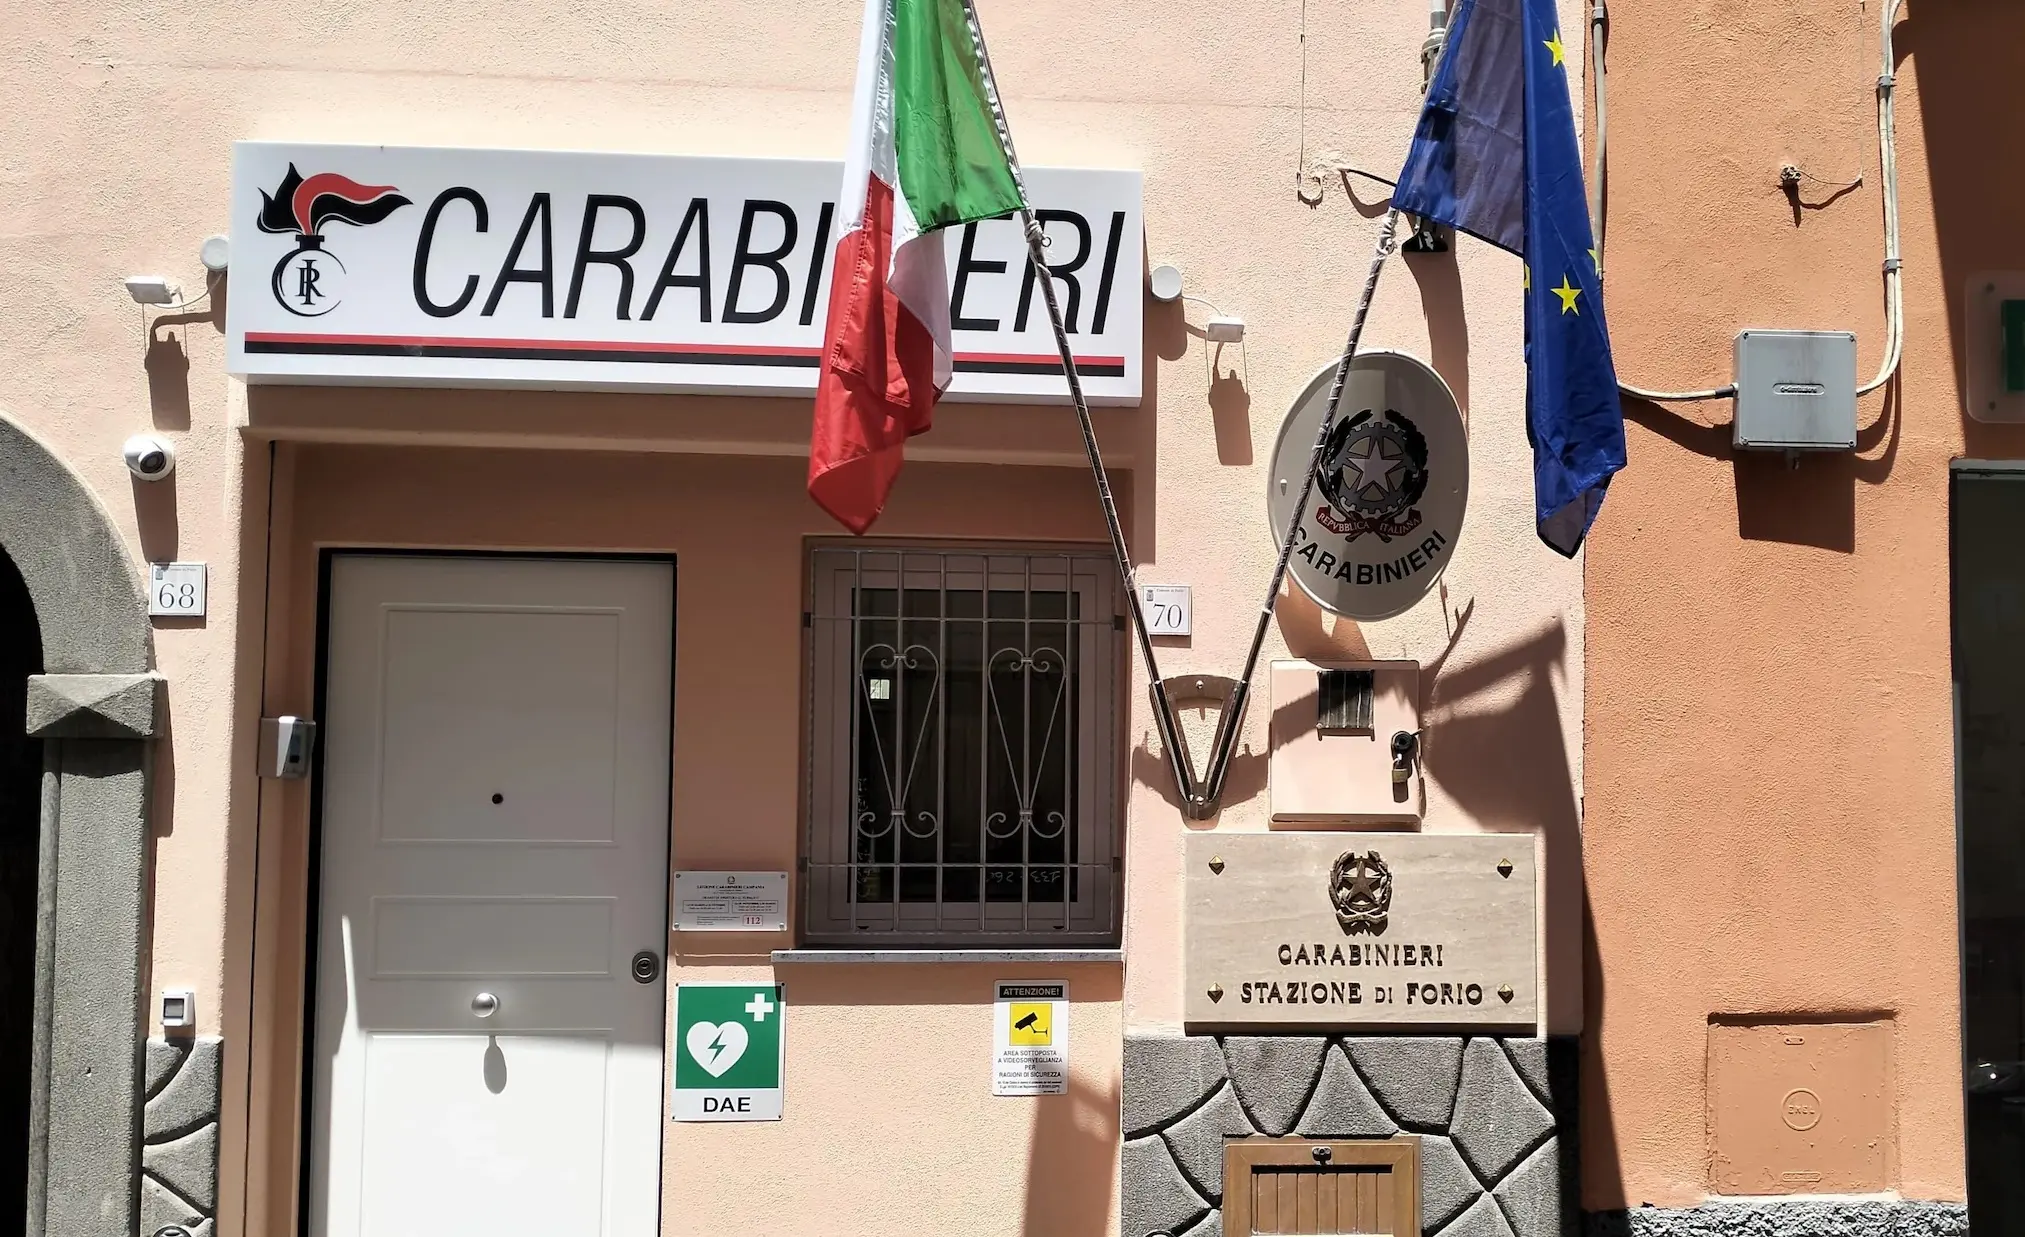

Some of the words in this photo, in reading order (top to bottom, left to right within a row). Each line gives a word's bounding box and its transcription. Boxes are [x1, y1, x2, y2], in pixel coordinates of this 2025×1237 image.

[412, 186, 1126, 335] CARABIERI
[1379, 518, 1420, 534] ITALIANA
[159, 583, 194, 608] 68
[1153, 603, 1182, 628] 70
[746, 917, 761, 925] 112
[1277, 944, 1444, 967] CARABINIERI
[1003, 987, 1060, 996] ATTENZIONE!
[1240, 982, 1363, 1005] STAZIONE
[1406, 982, 1483, 1006] FORIO
[703, 1097, 751, 1112] DAE
